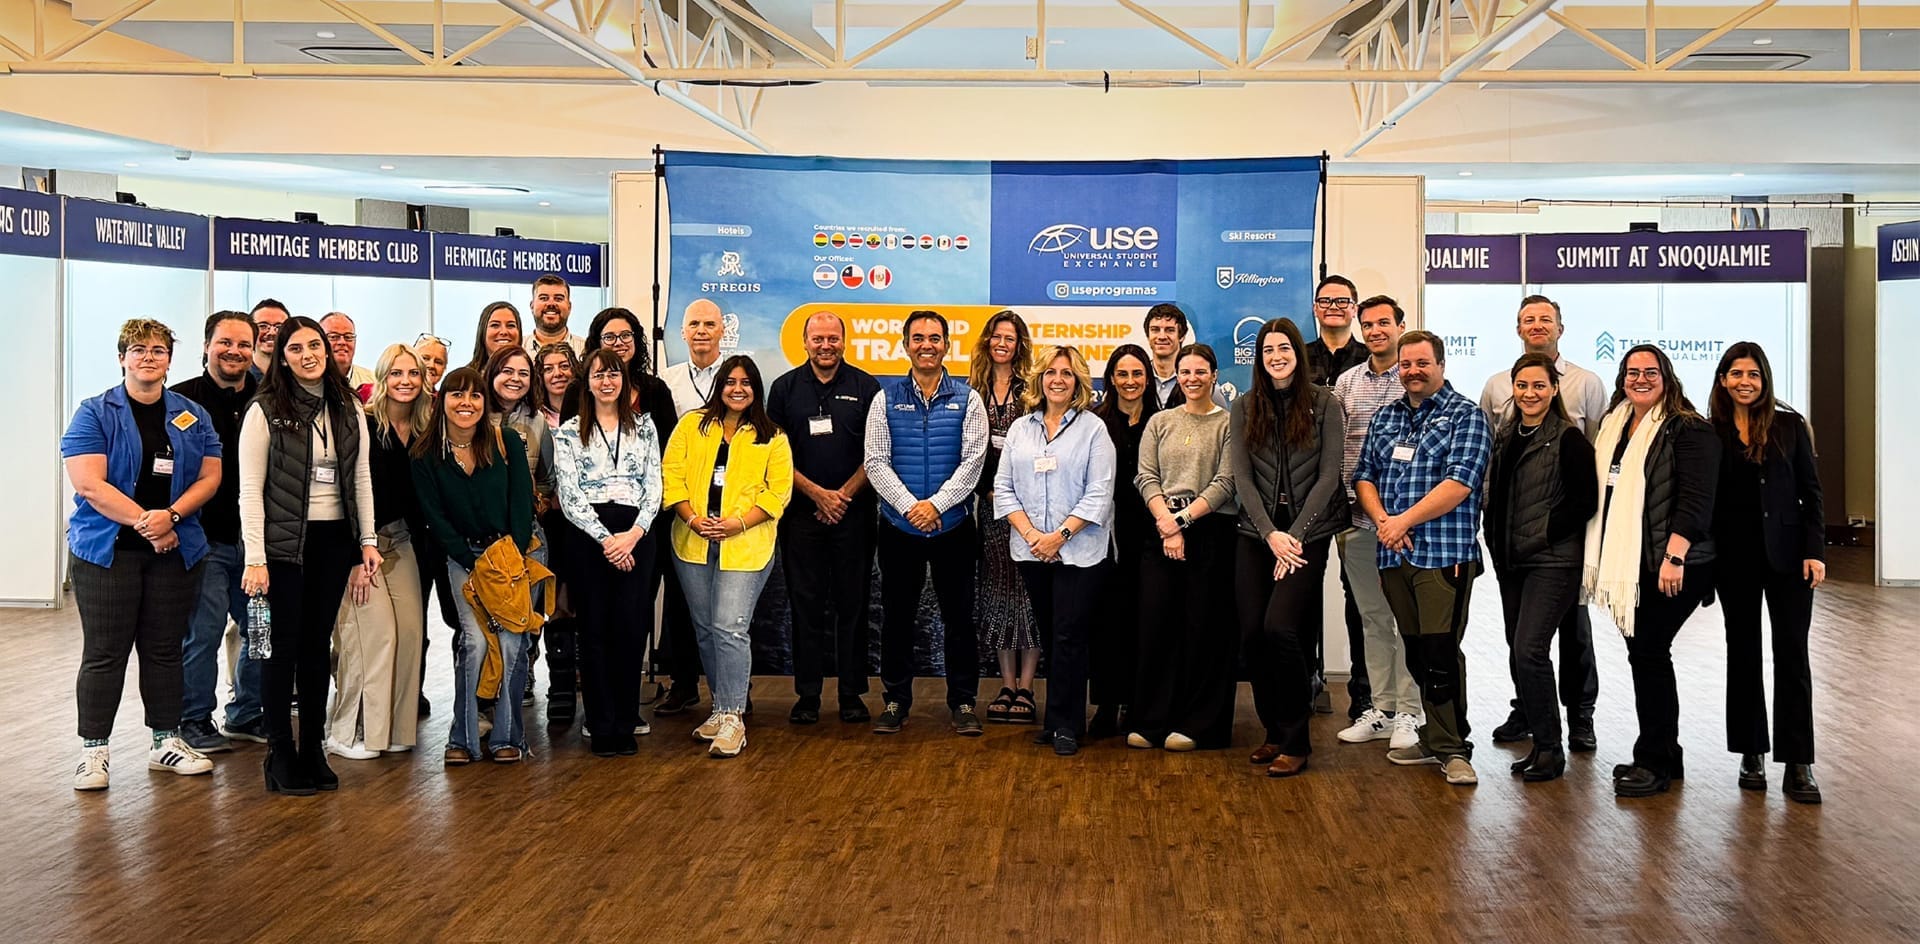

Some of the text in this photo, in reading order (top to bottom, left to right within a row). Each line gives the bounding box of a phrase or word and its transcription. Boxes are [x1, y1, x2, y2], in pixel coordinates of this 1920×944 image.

[21, 207, 50, 237] CLUB
[95, 217, 187, 251] WATERVILLE VALLEY
[717, 226, 745, 235] Hotels
[1090, 226, 1159, 250] use
[1228, 231, 1277, 241] Ski Resorts
[230, 232, 419, 264] HERMITAGE MEMBERS CLUB
[444, 246, 592, 274] HERMITAGE MEMBERS CLUB
[1063, 252, 1158, 260] UNIVERSAL STUDENT
[1425, 247, 1490, 273] QUALMIE
[1557, 244, 1771, 271] SUMMIT AT SNOQUALMIE
[1063, 260, 1159, 268] EXCHANGE
[719, 282, 761, 293] REGIS
[1235, 273, 1285, 287] Killington
[1071, 285, 1158, 297] useprogramas
[851, 318, 904, 335] WOR
[1028, 323, 1132, 339] TERNSHIP
[1234, 347, 1252, 357] BIG
[1658, 339, 1724, 352] SUMMIT
